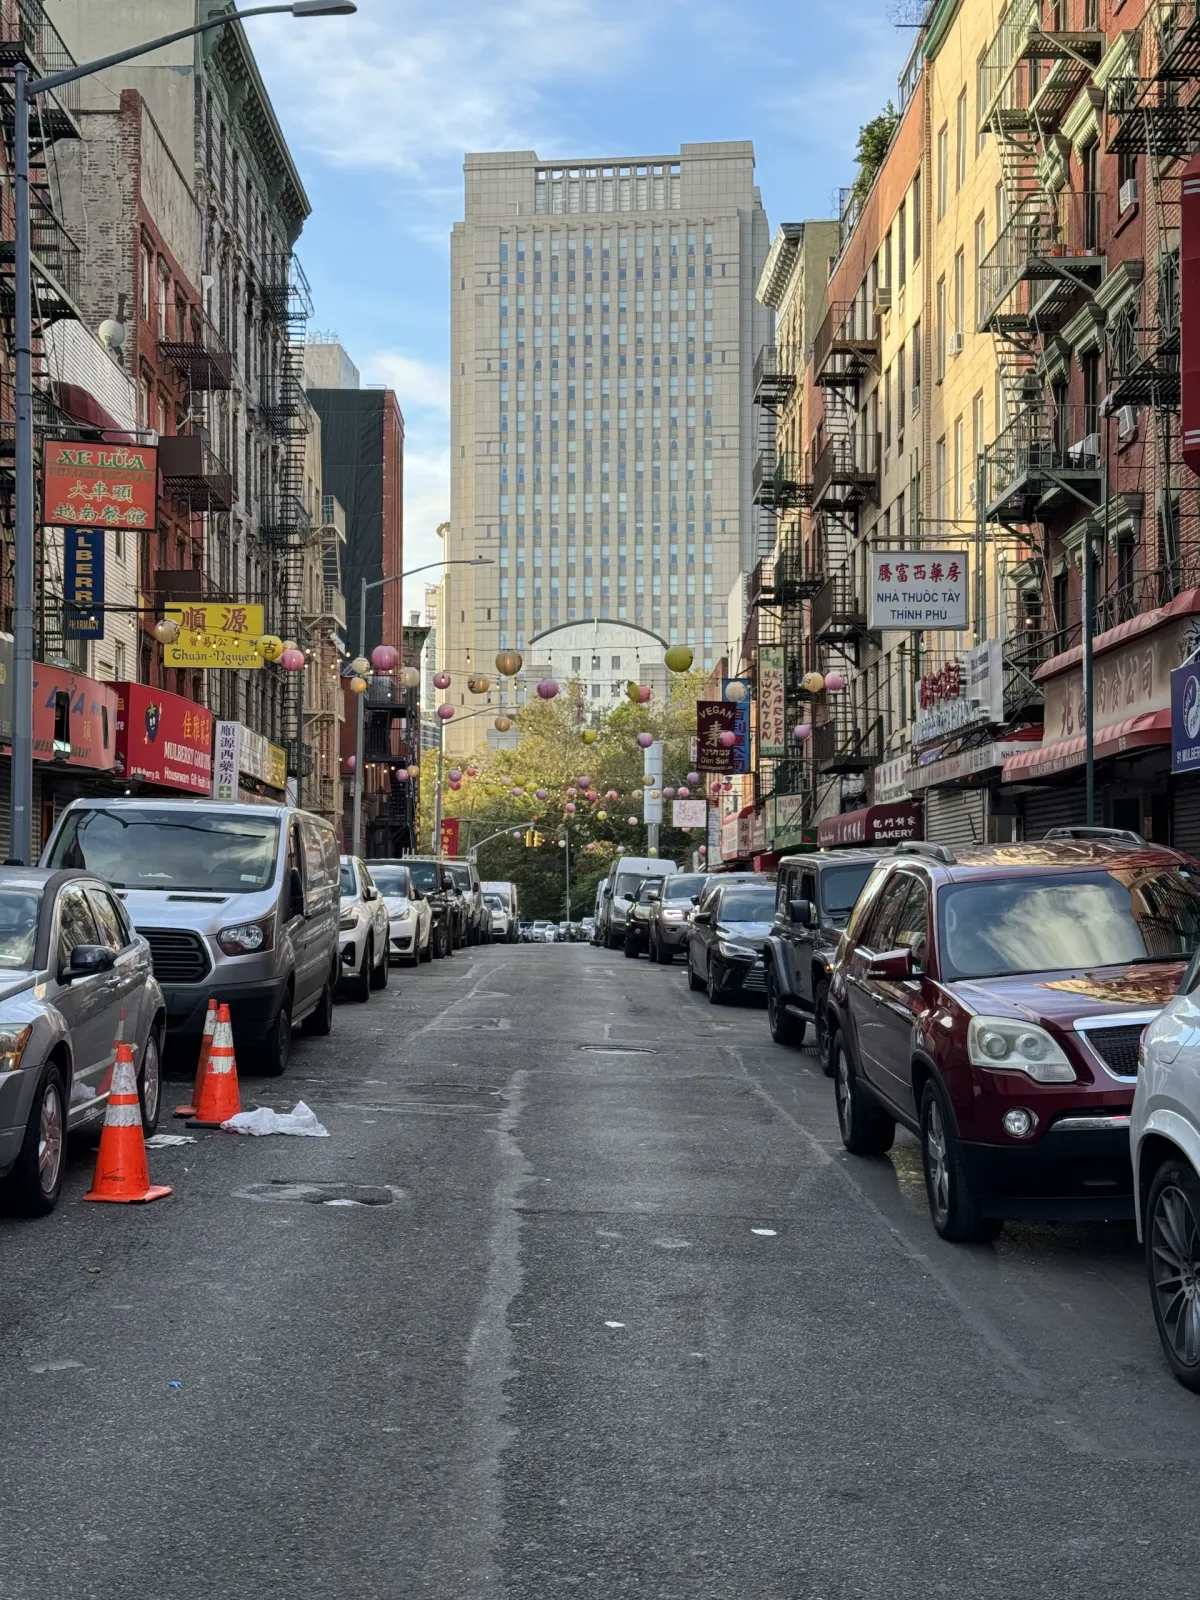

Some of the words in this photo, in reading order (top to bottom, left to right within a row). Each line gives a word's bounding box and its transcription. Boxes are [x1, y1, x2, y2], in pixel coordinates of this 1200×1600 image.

[57, 449, 93, 467] XE
[67, 480, 133, 503] 火車頭
[51, 502, 148, 526] 越南餐館
[942, 588, 961, 602] TÂY
[699, 706, 735, 719] VEGAN
[773, 684, 783, 746] GARDEN
[702, 721, 722, 747] 素
[164, 741, 194, 766] MULBERRY
[218, 725, 236, 785] 順源西藥房
[164, 766, 190, 784] Houseware
[875, 829, 913, 840] BAKERY
